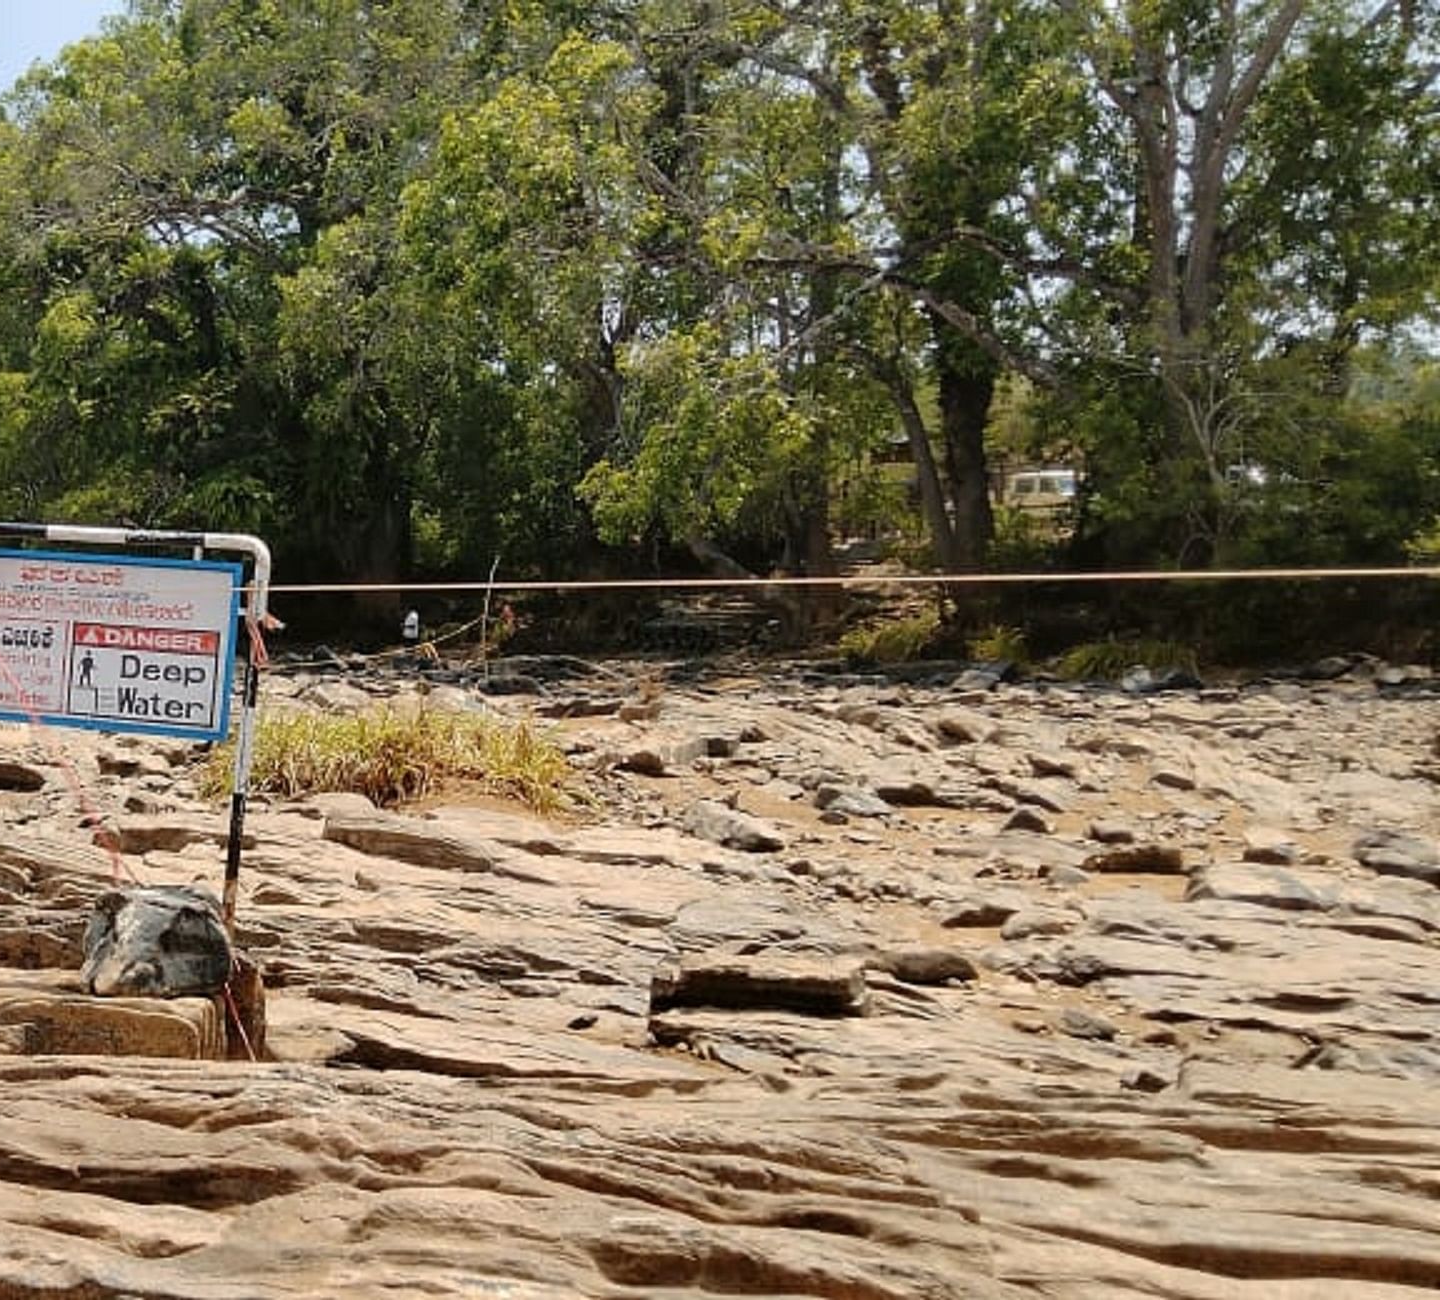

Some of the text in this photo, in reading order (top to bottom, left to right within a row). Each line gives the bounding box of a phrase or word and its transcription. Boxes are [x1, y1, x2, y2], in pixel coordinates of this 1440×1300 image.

[104, 627, 202, 652] DANGER
[120, 655, 206, 686] Deep
[118, 688, 205, 718] Water
